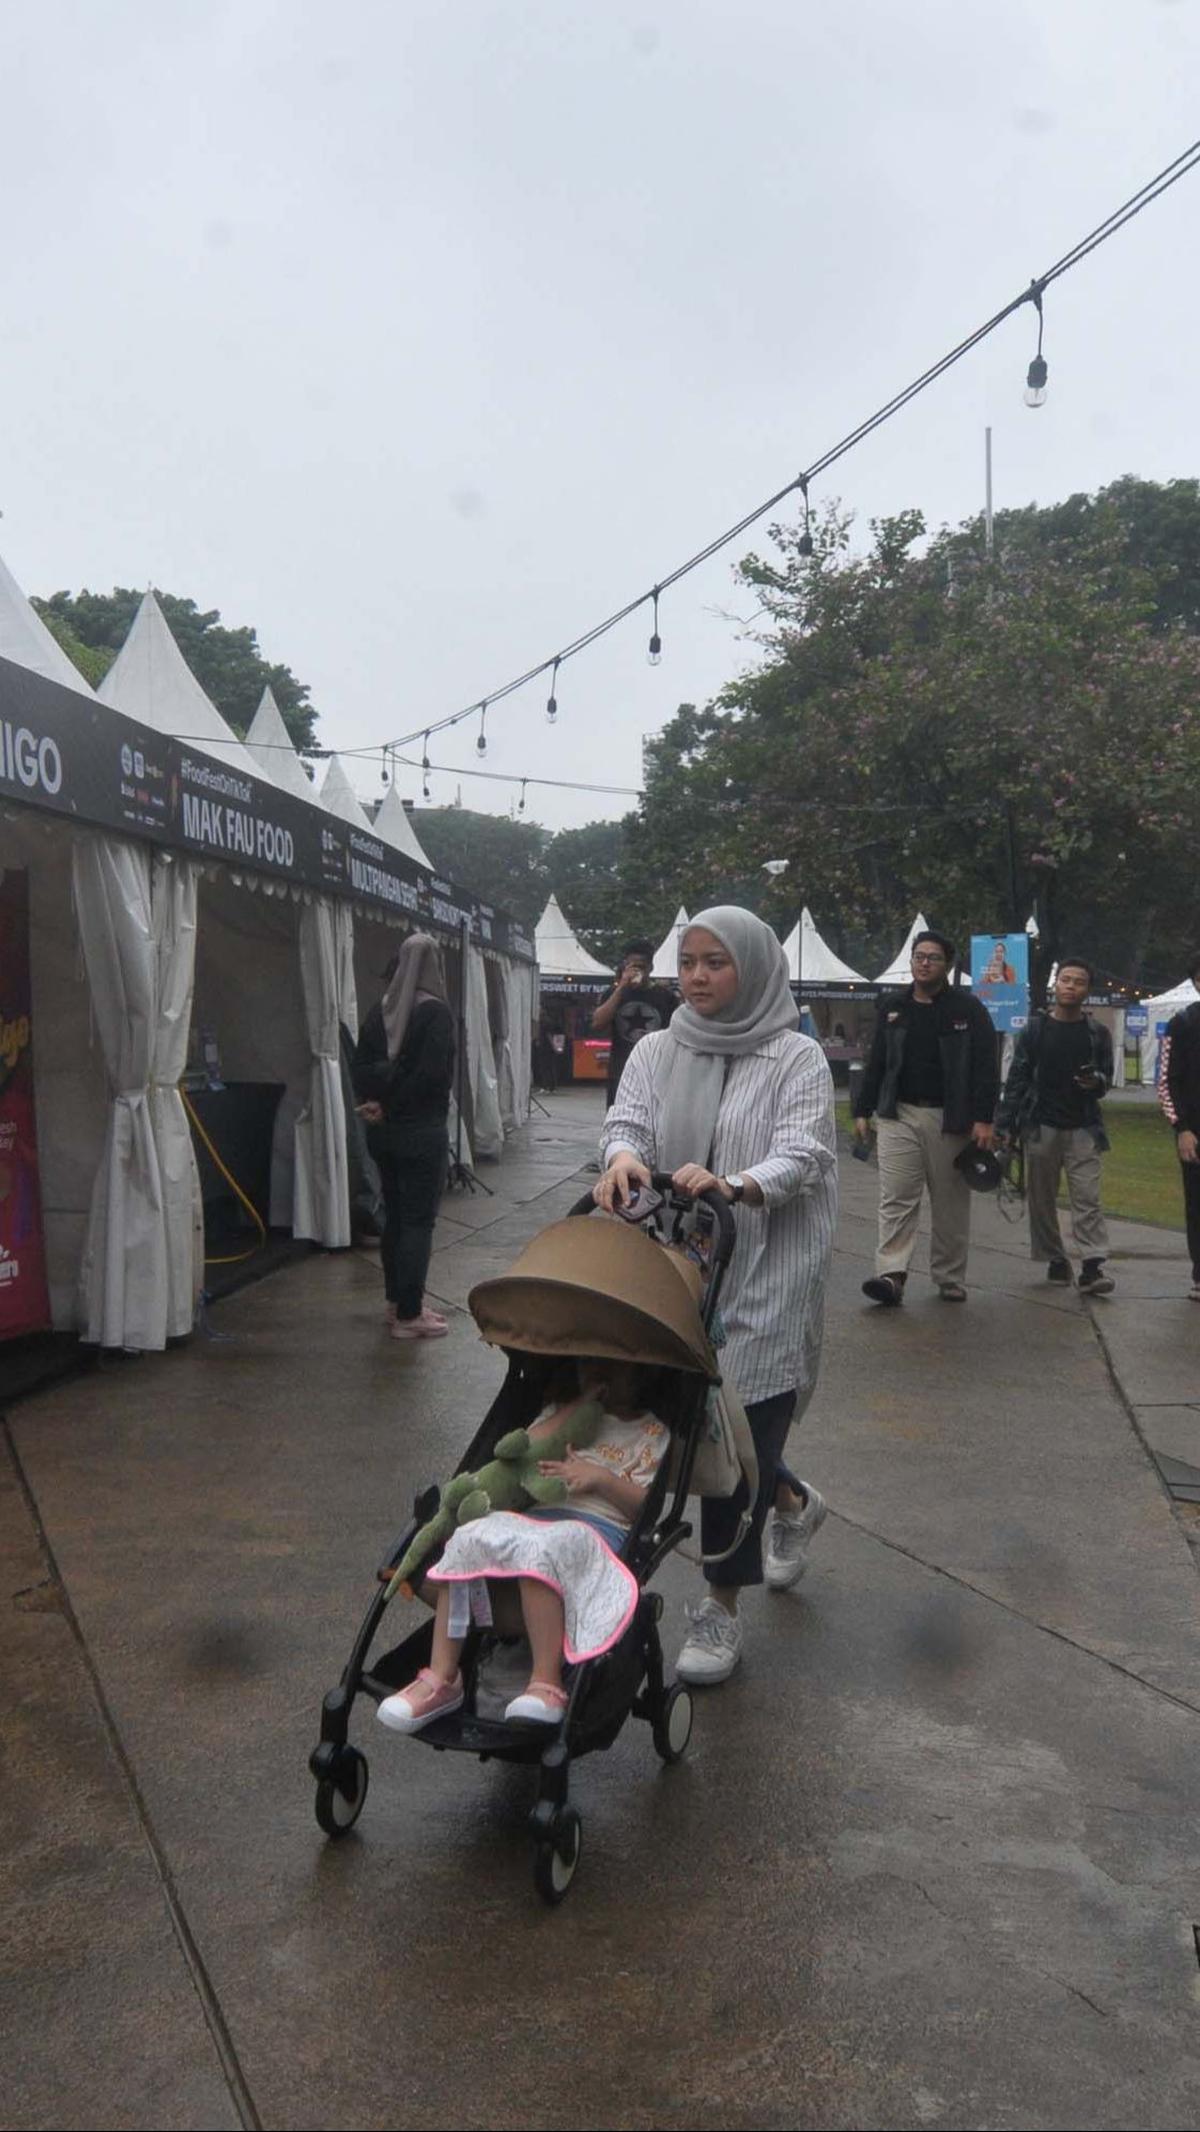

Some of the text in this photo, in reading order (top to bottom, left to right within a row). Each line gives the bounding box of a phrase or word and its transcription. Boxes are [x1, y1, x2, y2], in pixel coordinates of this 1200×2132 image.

[182, 792, 225, 848] MAK
[226, 808, 254, 856] FAU
[256, 819, 294, 867] FOOD
[580, 984, 593, 993] BY
